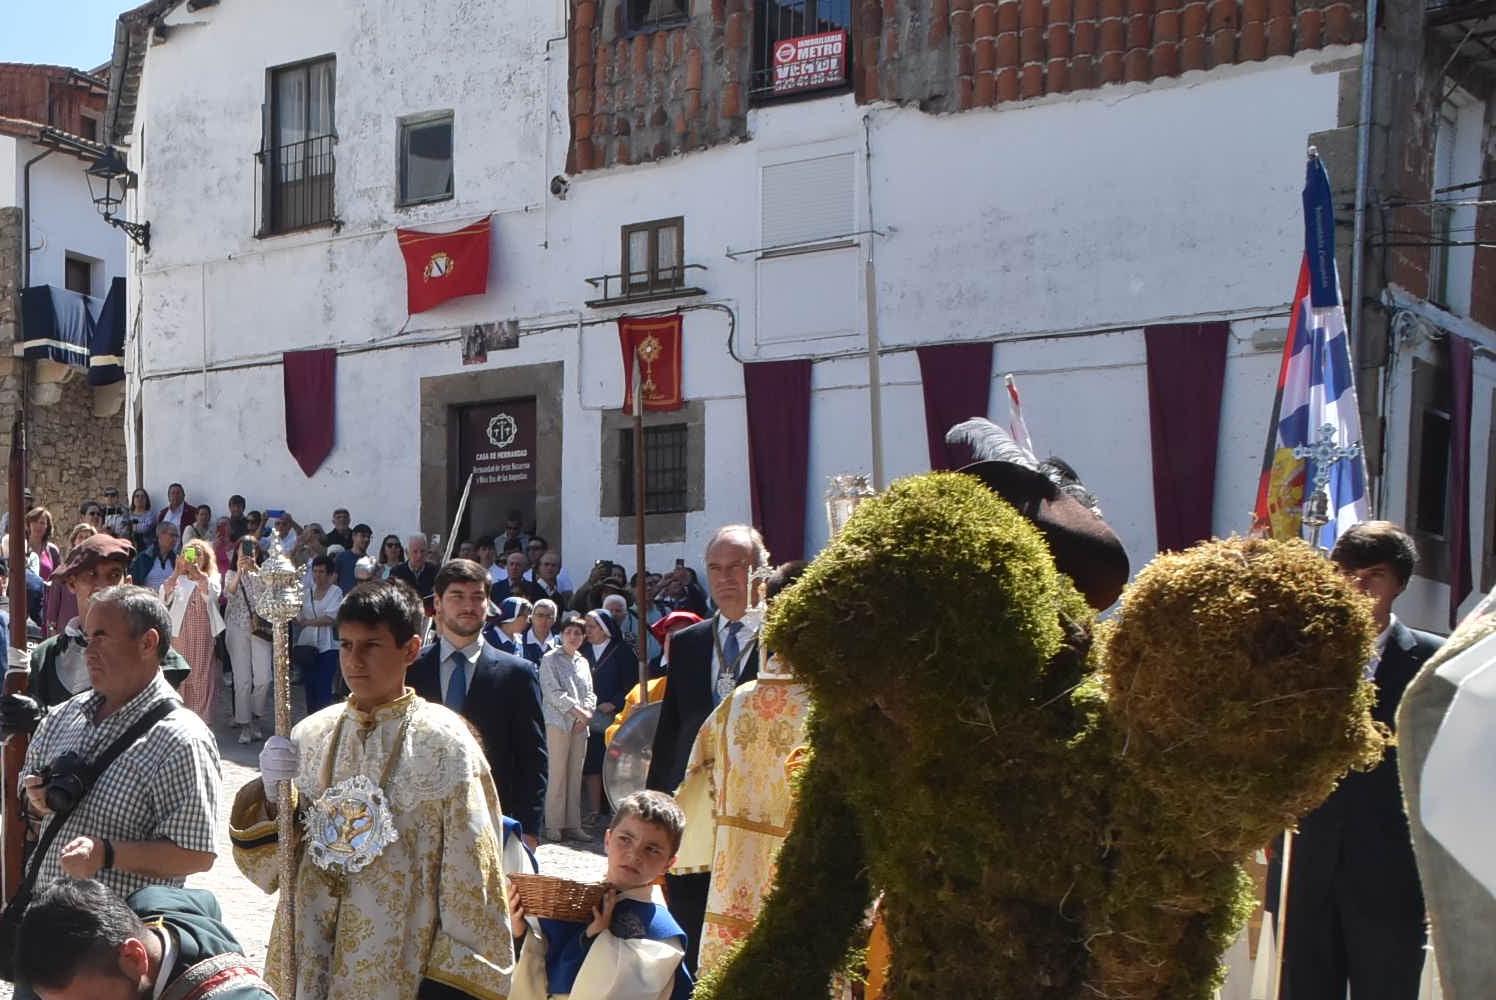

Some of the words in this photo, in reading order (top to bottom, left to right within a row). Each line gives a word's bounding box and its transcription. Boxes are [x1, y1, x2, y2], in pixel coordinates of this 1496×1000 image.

[797, 42, 842, 60] METRO
[475, 453, 489, 461] CASA
[489, 451, 496, 460] DE
[497, 449, 527, 459] HERMANDAD
